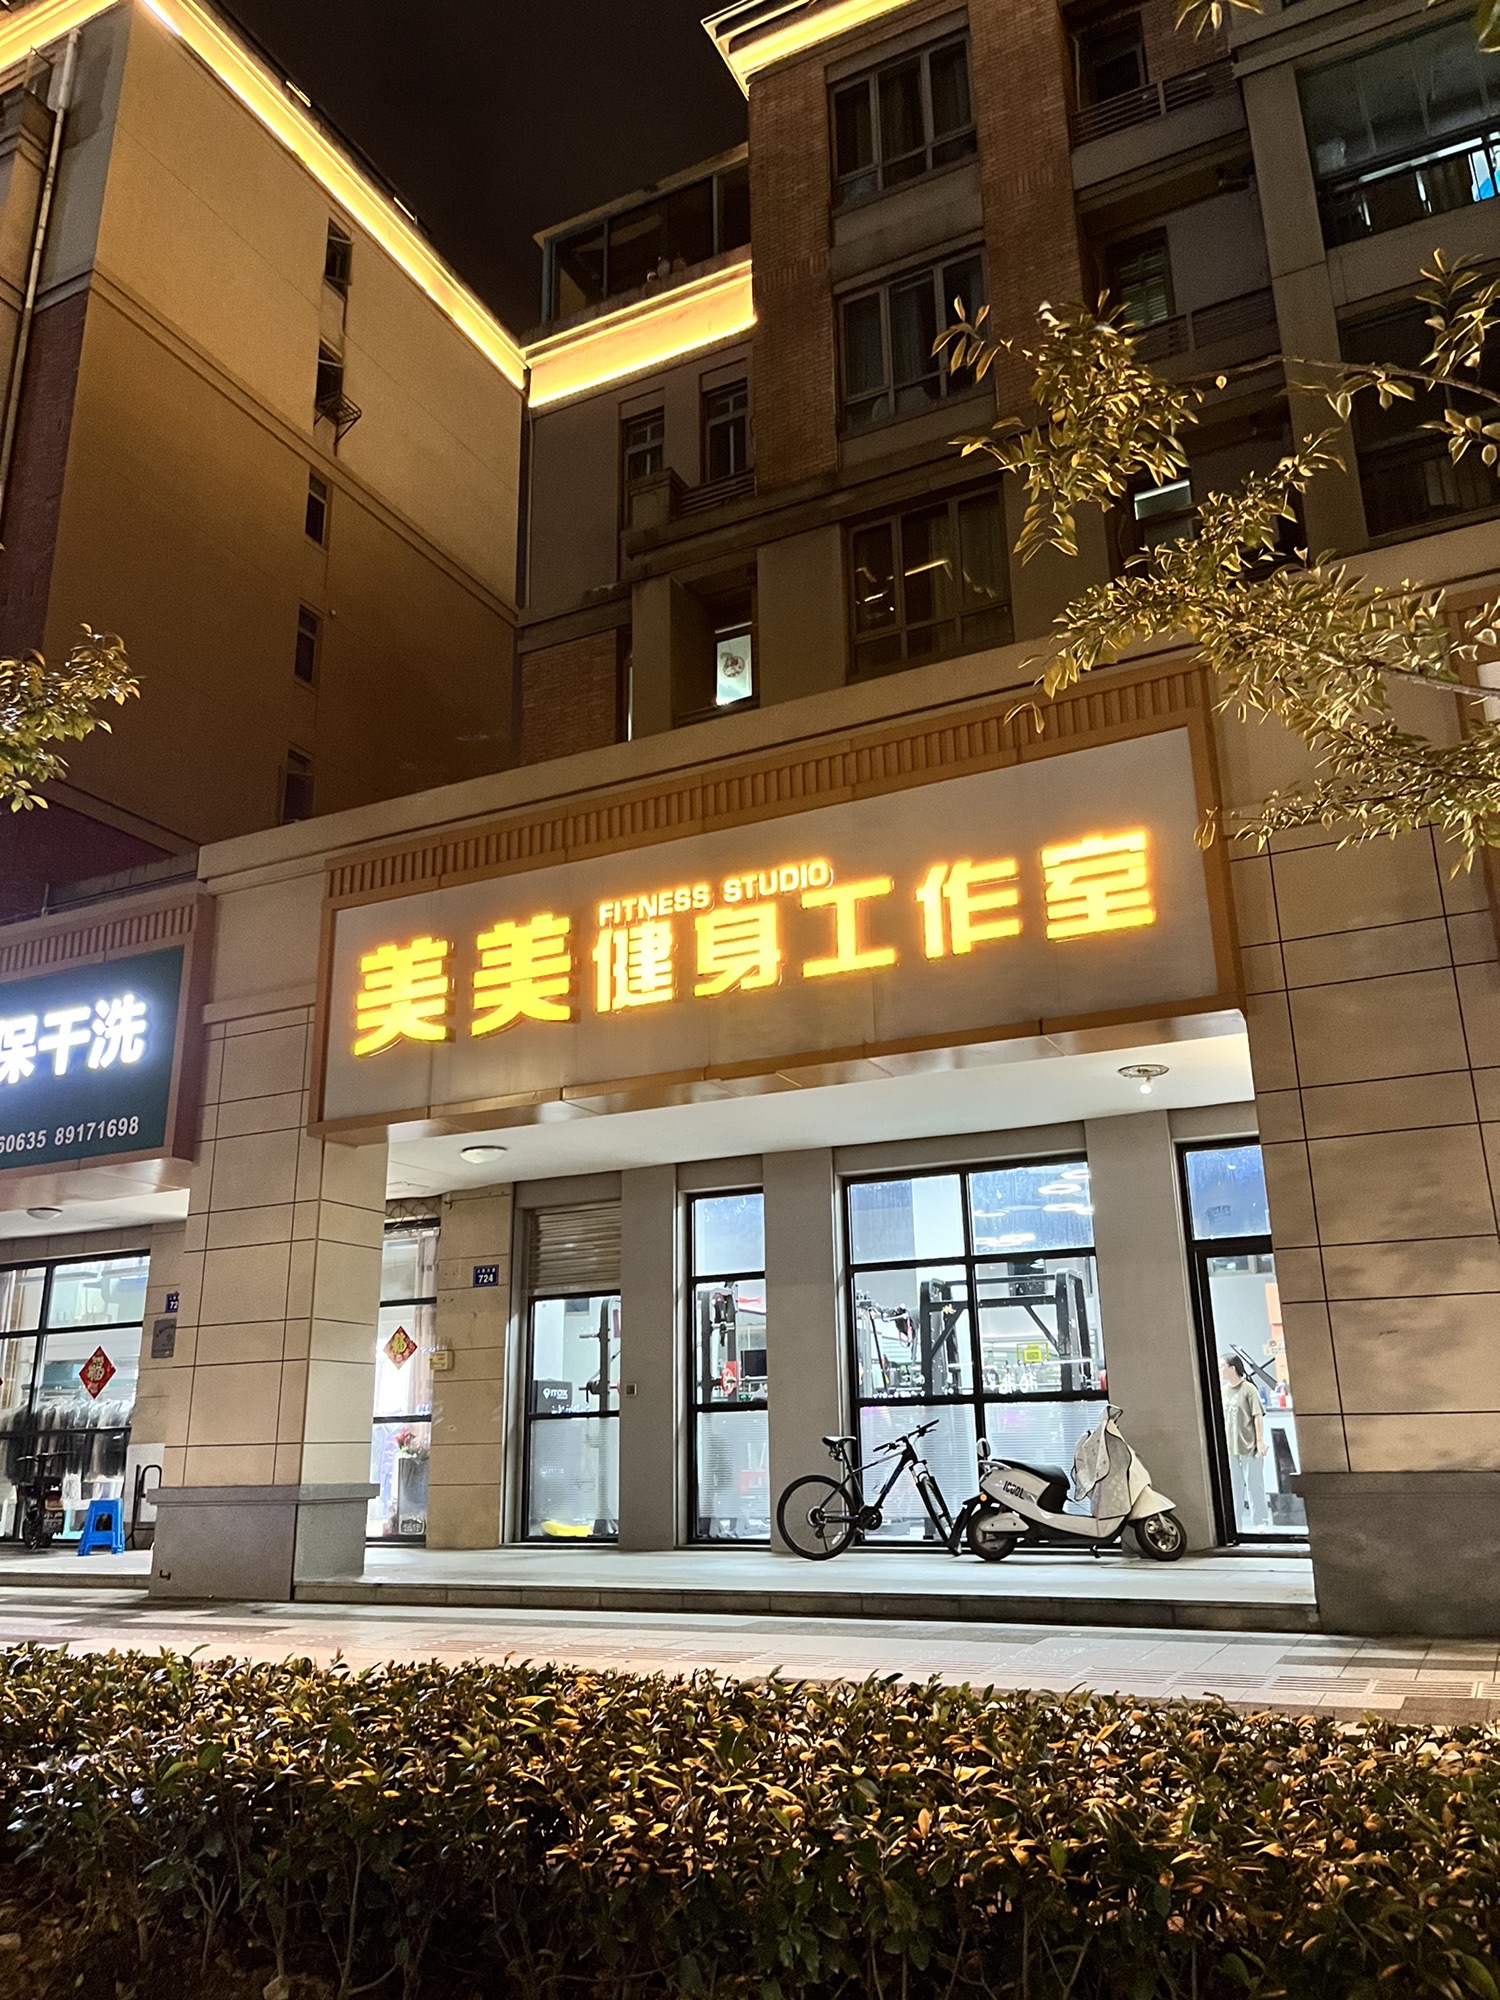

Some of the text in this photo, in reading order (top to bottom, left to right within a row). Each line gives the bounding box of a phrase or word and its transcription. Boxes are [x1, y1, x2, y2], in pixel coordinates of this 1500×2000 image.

[598, 860, 831, 927] FITNESS STUDIO
[354, 829, 1155, 1057] 美美健身工作室
[54, 1115, 139, 1146] 89171698
[478, 1273, 494, 1284] 724
